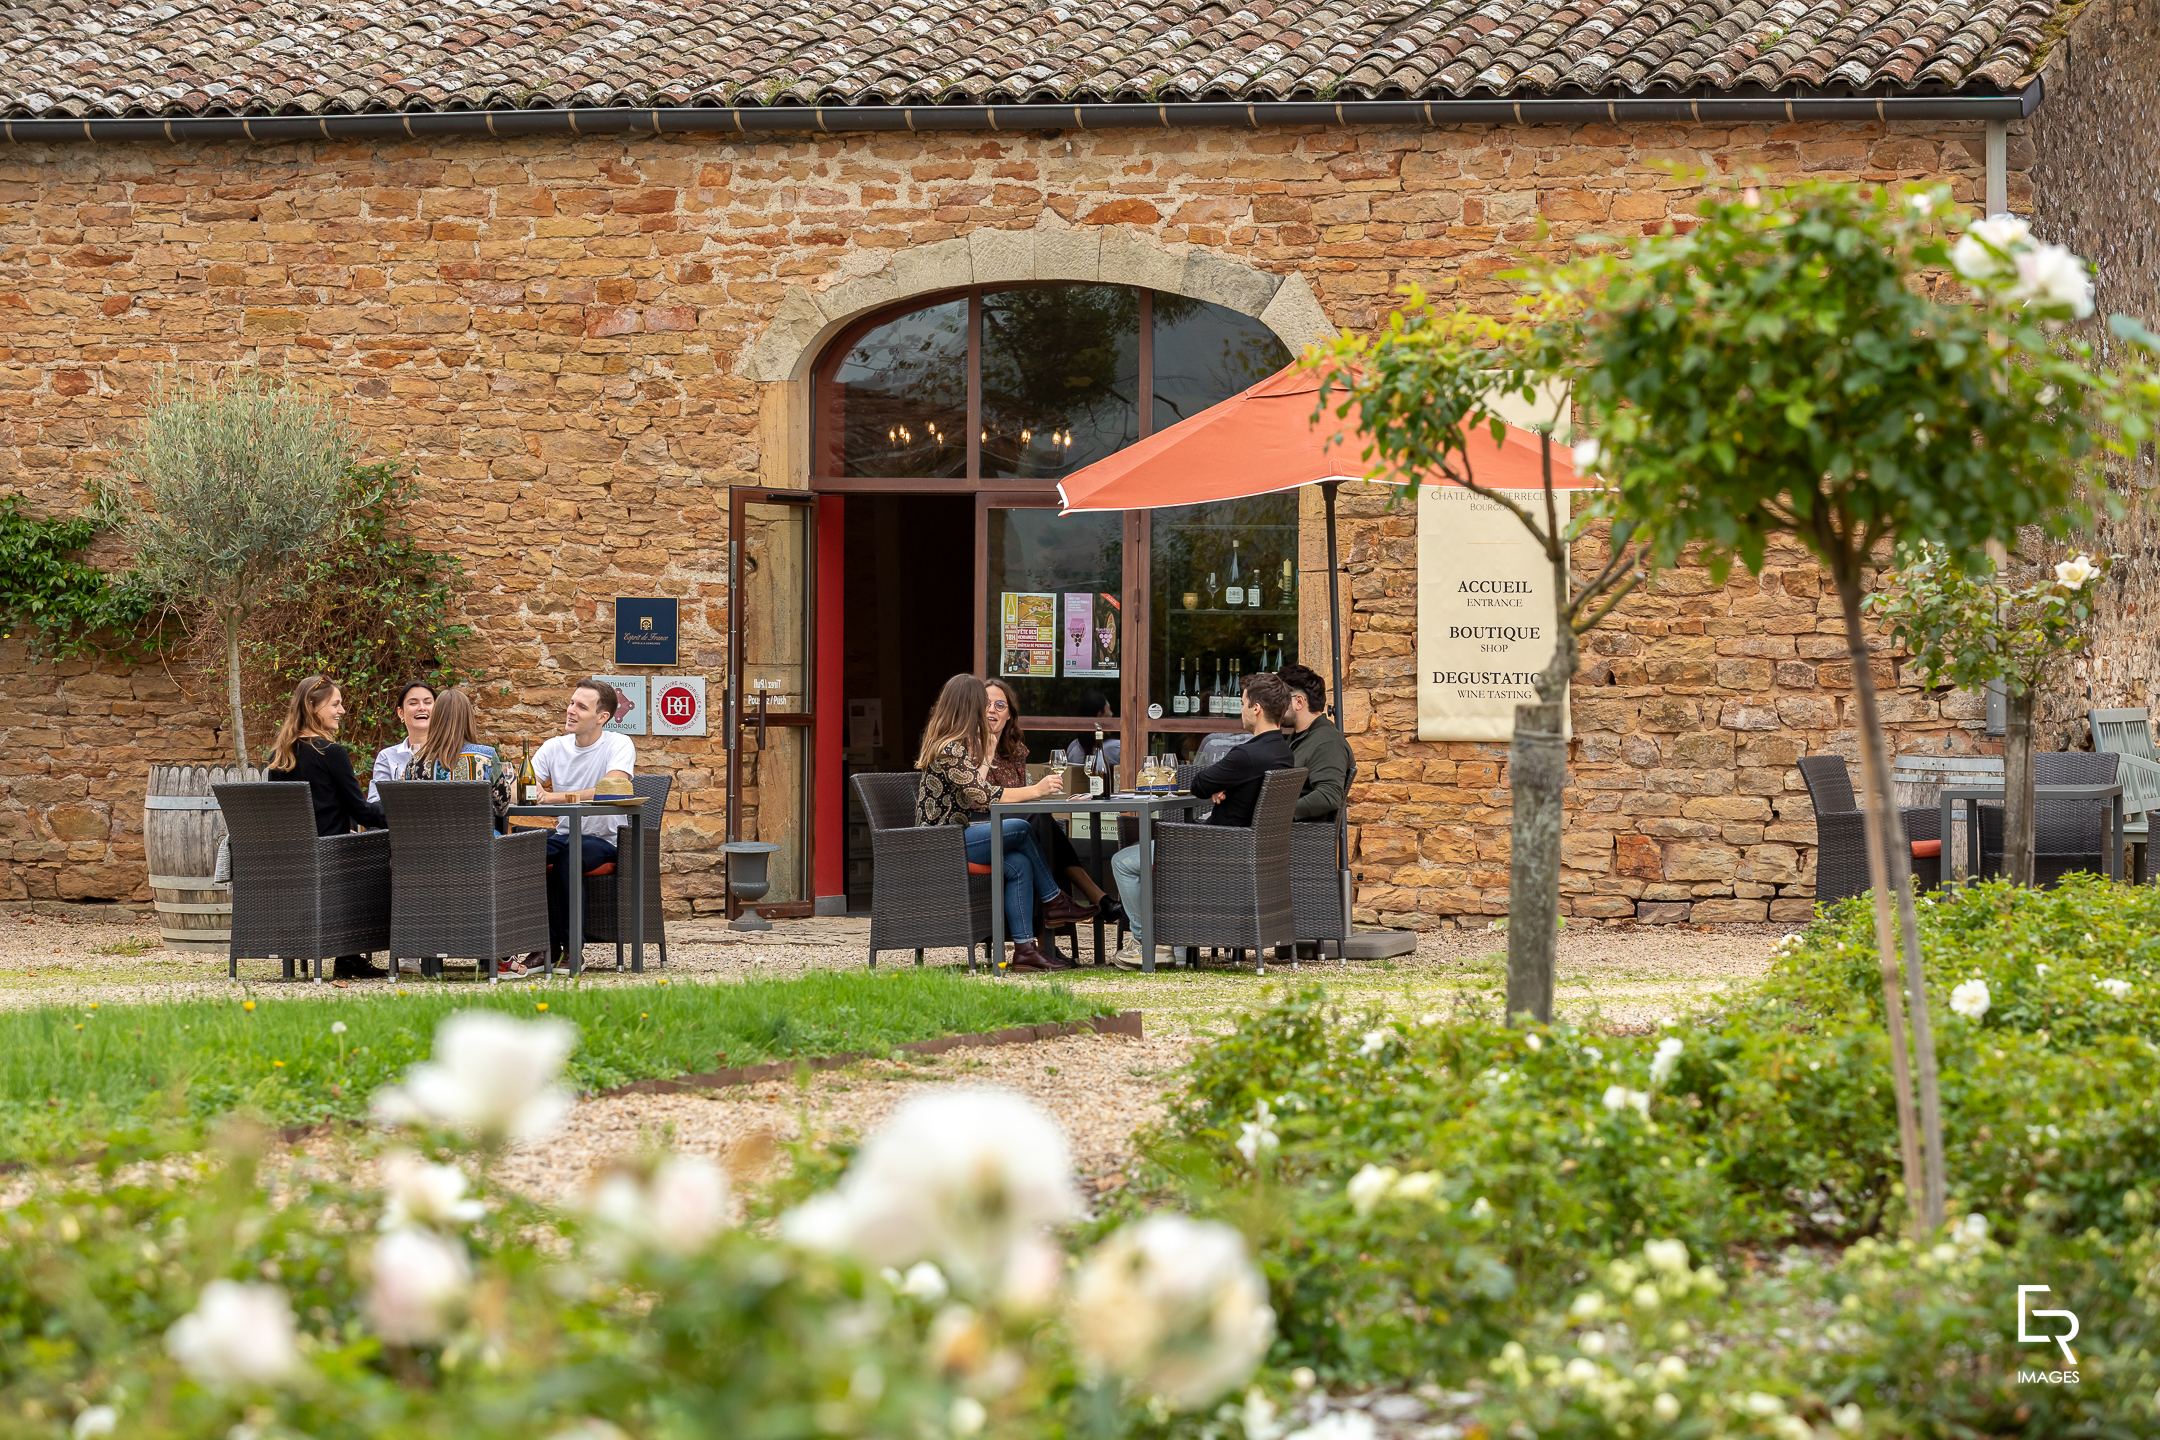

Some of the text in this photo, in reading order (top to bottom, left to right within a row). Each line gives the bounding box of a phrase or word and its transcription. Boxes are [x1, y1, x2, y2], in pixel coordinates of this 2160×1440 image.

[1499, 491, 1558, 501] PIERRECLS
[1457, 580, 1533, 594] ACCUEIL
[1466, 598, 1523, 607] ENTRANCE
[1449, 626, 1541, 642] BOUTIQUE
[1480, 644, 1509, 653] SHOP
[1432, 671, 1541, 685] DEGUSTATIO
[1457, 690, 1532, 699] WINE TASTING
[773, 695, 787, 705] Push
